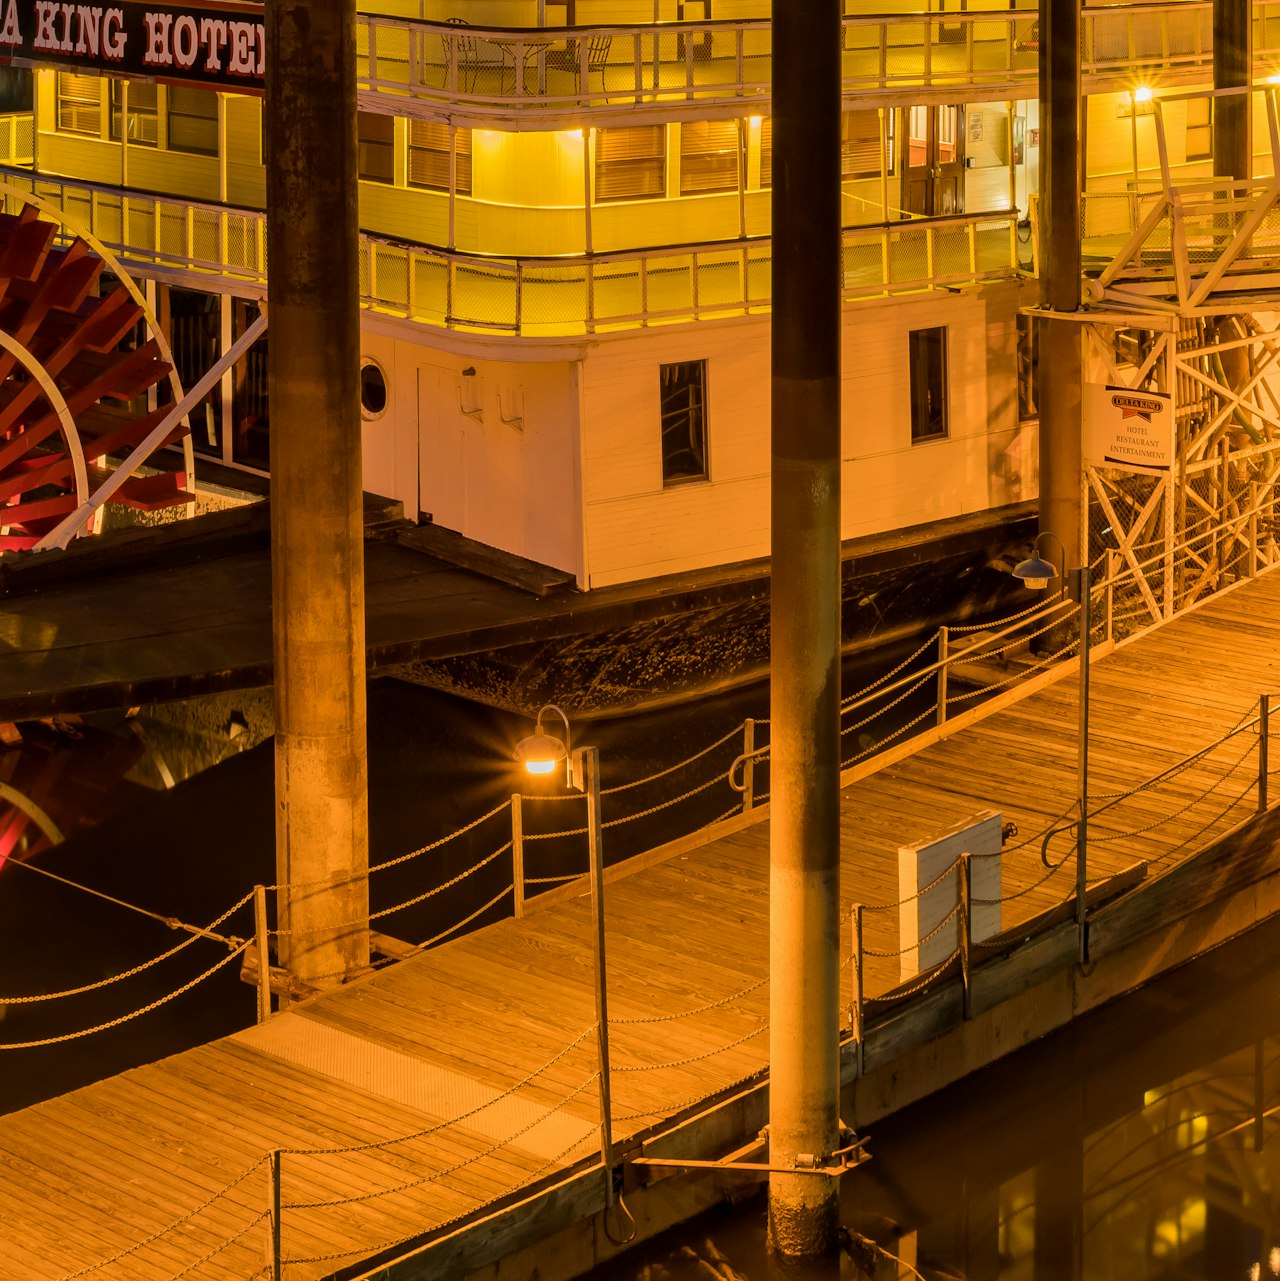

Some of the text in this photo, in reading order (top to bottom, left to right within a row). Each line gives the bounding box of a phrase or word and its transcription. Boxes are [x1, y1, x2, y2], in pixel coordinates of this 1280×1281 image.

[33, 0, 128, 60] KING
[1116, 397, 1160, 411] DELTA KING
[1126, 426, 1149, 435] HOTEL
[1116, 435, 1160, 448] RESTAURANT
[1110, 444, 1165, 459] ENTERTAINMENT
